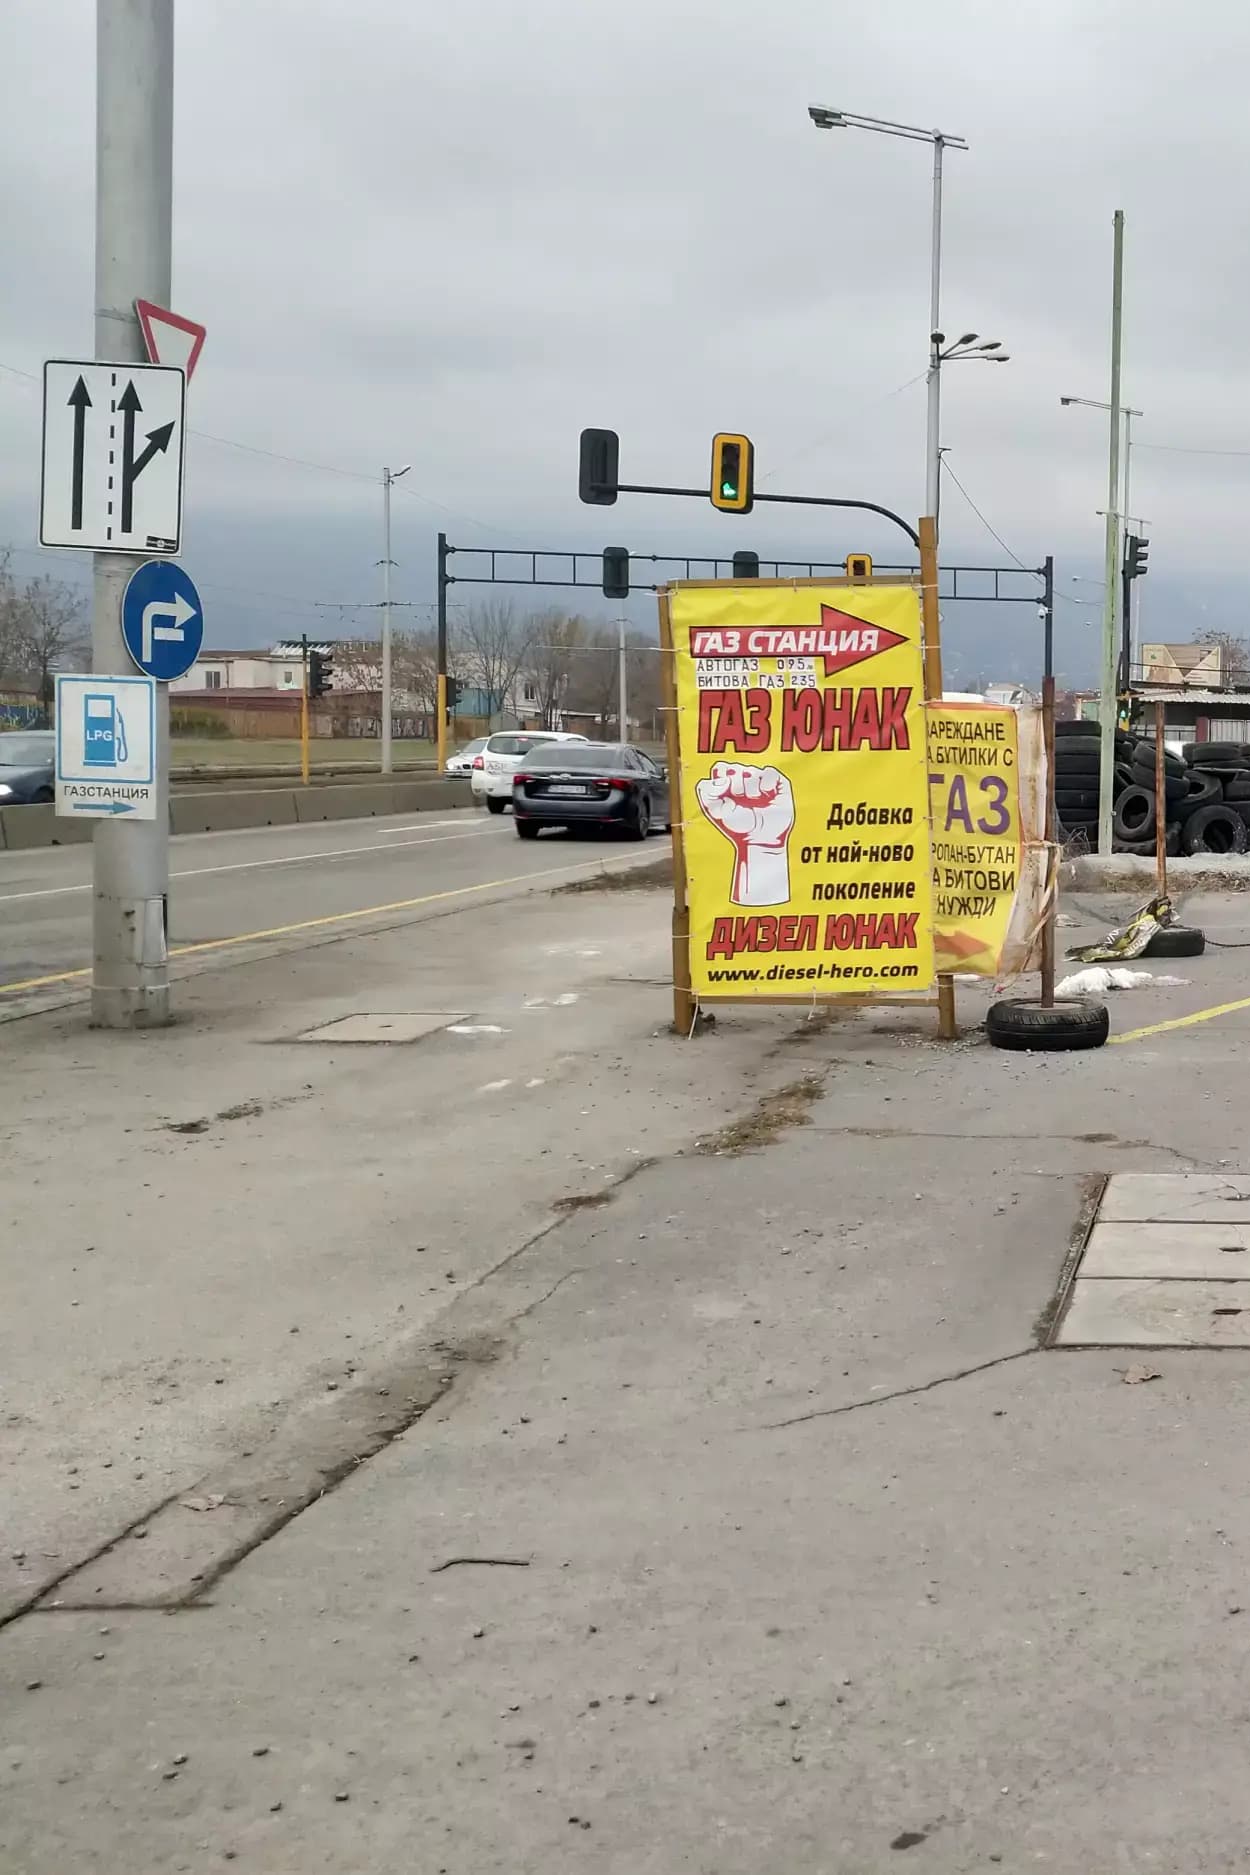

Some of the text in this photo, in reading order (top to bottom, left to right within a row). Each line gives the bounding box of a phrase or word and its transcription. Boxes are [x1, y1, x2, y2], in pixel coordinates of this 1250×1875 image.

[693, 630, 879, 656] ГАЗ СТАНЦИЯ
[697, 659, 759, 672] АВТОГАЗ
[698, 674, 816, 688] БИТОВА ГАЗ 235
[697, 687, 913, 753] ГАЗ ЮНАК
[927, 720, 1006, 743] АРЕЖДАНЕ
[86, 730, 113, 741] LPG
[936, 746, 998, 766] БУТИЛКИ
[1002, 748, 1014, 767] С
[64, 785, 149, 800] ГАЗСТАНЦИЯ
[826, 801, 914, 831] Добавка
[800, 840, 914, 863] от най-ново
[812, 881, 915, 901] поколение
[945, 868, 1015, 892] БИТОВИ
[936, 894, 997, 919] НУЖДИ
[705, 912, 921, 960] ДИЗЕЛ ЮНАК
[707, 963, 919, 982] www.diesel-hero.com
